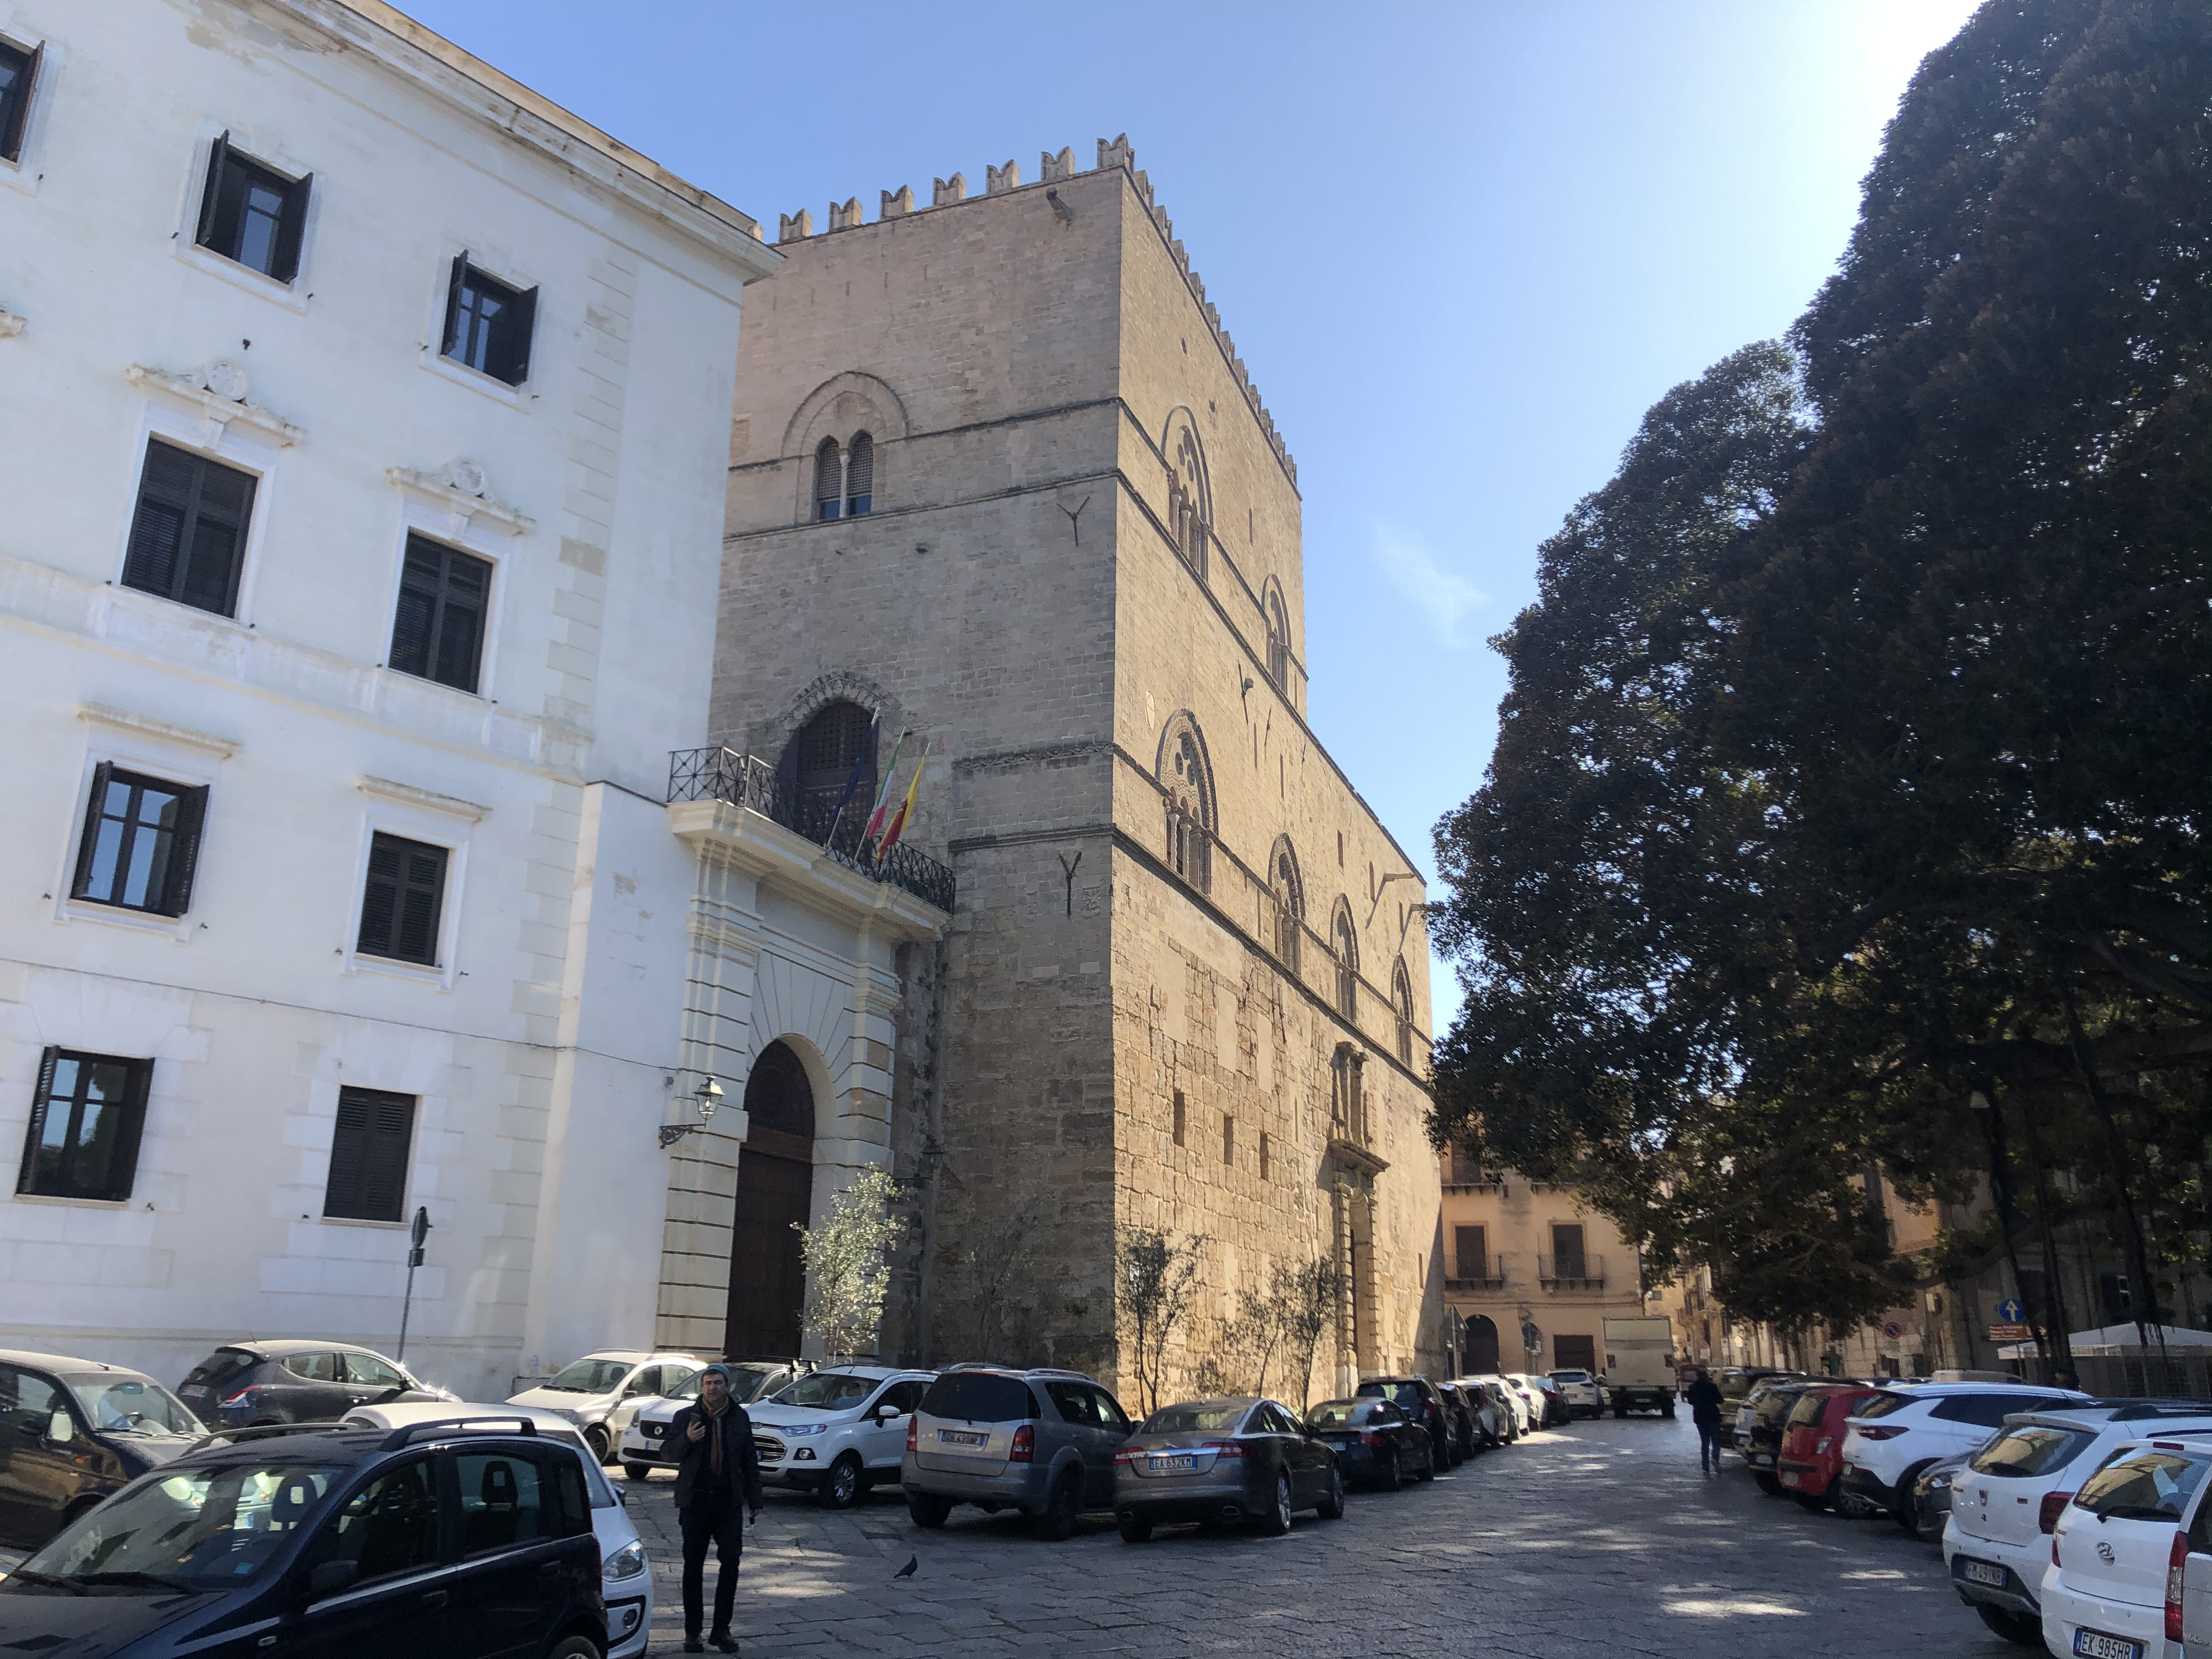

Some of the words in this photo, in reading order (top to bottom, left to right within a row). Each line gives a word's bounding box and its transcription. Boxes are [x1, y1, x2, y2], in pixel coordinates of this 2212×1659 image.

[1155, 1458, 1164, 1468] EA
[1166, 1457, 1191, 1467] 632KM
[2082, 1634, 2095, 1653] EK
